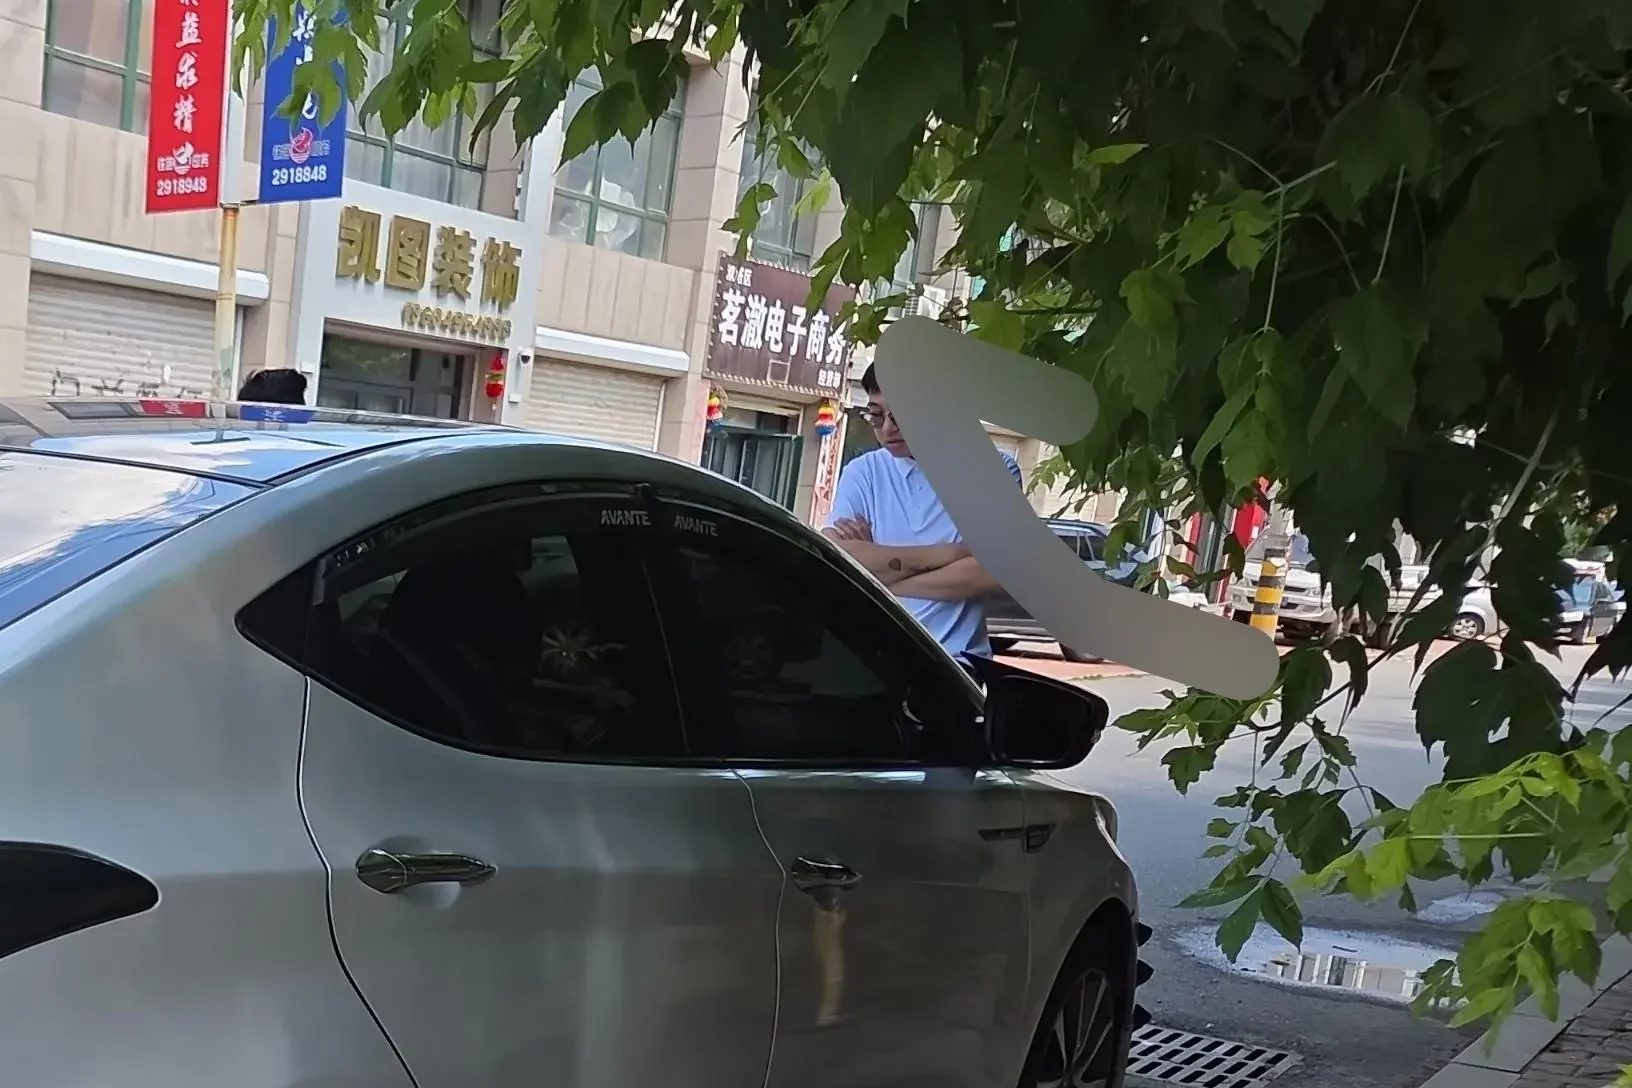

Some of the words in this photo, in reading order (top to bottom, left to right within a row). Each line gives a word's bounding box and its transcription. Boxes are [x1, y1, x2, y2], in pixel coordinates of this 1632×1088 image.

[173, 0, 204, 134] 益求精
[271, 165, 328, 186] 2918848
[335, 205, 523, 311] 凯图装饰
[600, 508, 652, 527] AVANTE
[674, 513, 719, 538] AVANTE
